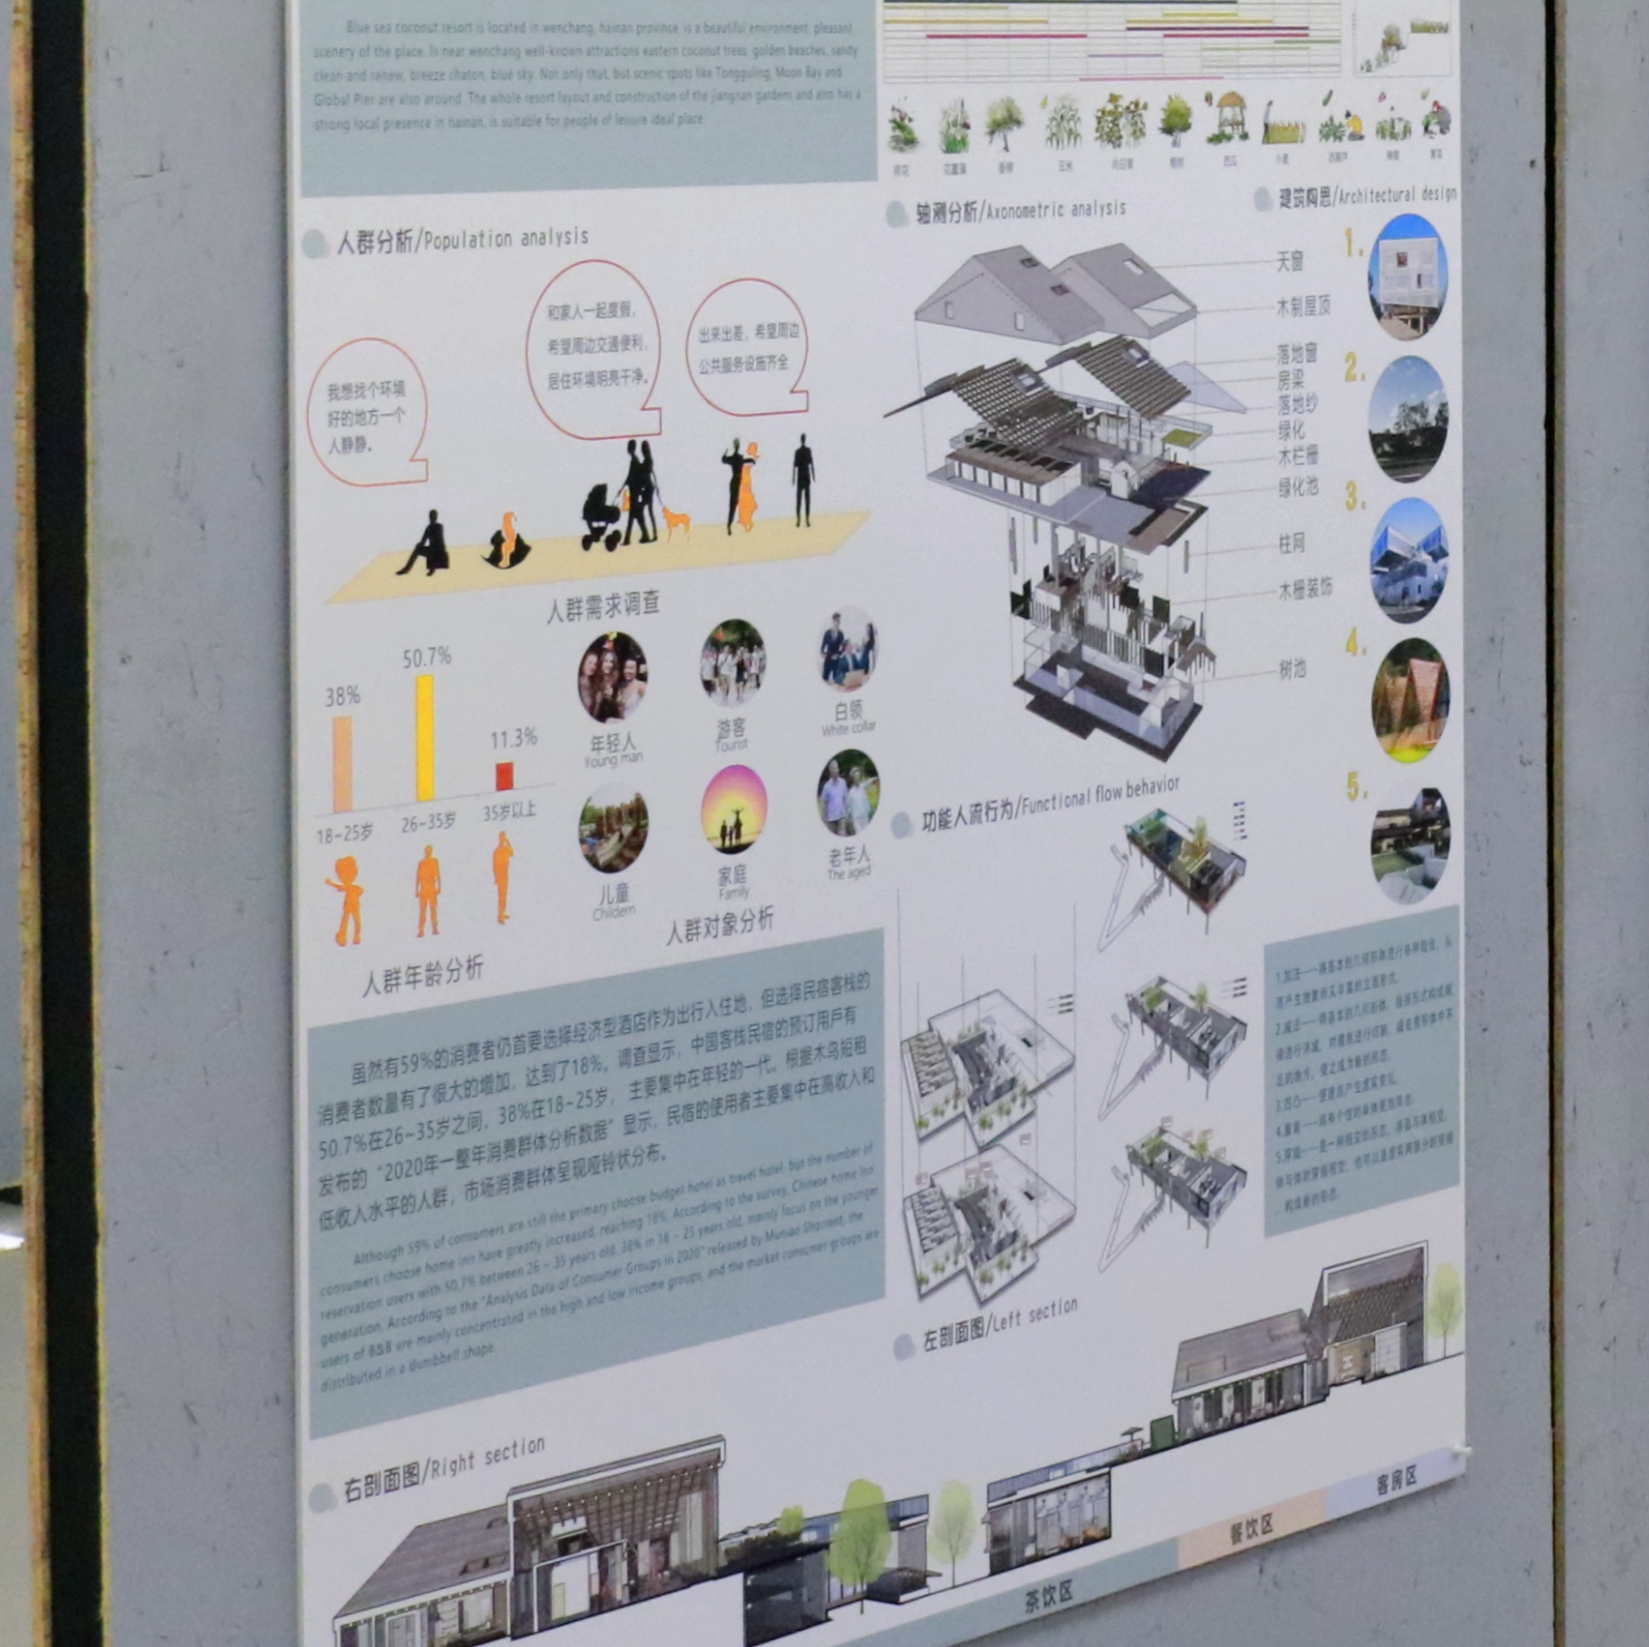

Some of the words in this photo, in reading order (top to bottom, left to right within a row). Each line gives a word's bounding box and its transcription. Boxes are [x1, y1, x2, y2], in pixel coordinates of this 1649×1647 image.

[1422, 185, 1458, 204] design
[916, 199, 1065, 226] 轴测分析/Axonometric
[1070, 198, 1127, 219] analysis
[337, 228, 513, 256] 人群分析/Population
[521, 227, 589, 250] analysis
[1344, 228, 1365, 257] 1.
[1277, 250, 1304, 273] 天窗
[1277, 294, 1331, 319] 木制屋顶
[1277, 342, 1318, 366] 落地窗
[1277, 367, 1305, 390] 房梁
[1344, 352, 1367, 382] 2.
[327, 406, 407, 429] 好的地方一个
[1278, 419, 1306, 441] 绿化
[1278, 474, 1319, 498] 绿化池
[1345, 481, 1367, 511] 3.
[546, 588, 661, 626] 人群需求调查
[1345, 627, 1368, 657] 4.
[402, 646, 453, 670] 50.7%
[1279, 657, 1307, 680] 树池
[325, 686, 362, 709] 38%
[835, 700, 864, 722] 白领
[490, 726, 538, 750] 11.3%
[716, 717, 746, 739] 游客
[821, 722, 854, 738] White
[855, 720, 877, 735] collar
[589, 731, 638, 754] 年轻人
[715, 736, 749, 753] Tourist
[584, 753, 618, 771] Young
[621, 752, 644, 766] man
[1095, 783, 1123, 804] flow
[1126, 774, 1181, 801] behavior
[1346, 771, 1369, 800] 5.
[483, 799, 537, 822] 35岁以上
[828, 844, 872, 869] 老年人
[717, 864, 747, 887] 家庭
[827, 866, 846, 881] The
[848, 865, 872, 881] aged
[599, 882, 630, 906] 儿童
[718, 885, 750, 901] Family
[666, 905, 775, 948] 人群对象分析
[362, 954, 485, 999] 人群年龄分析
[923, 1310, 1022, 1352] 左剖面图/Left
[1028, 1295, 1078, 1326] section
[343, 1448, 477, 1505] 右剖面图/Right
[485, 1435, 546, 1466] section
[1376, 1464, 1418, 1497] 客房区
[1229, 1511, 1275, 1545] 餐饮区
[1025, 1577, 1075, 1614] 茶饮区
